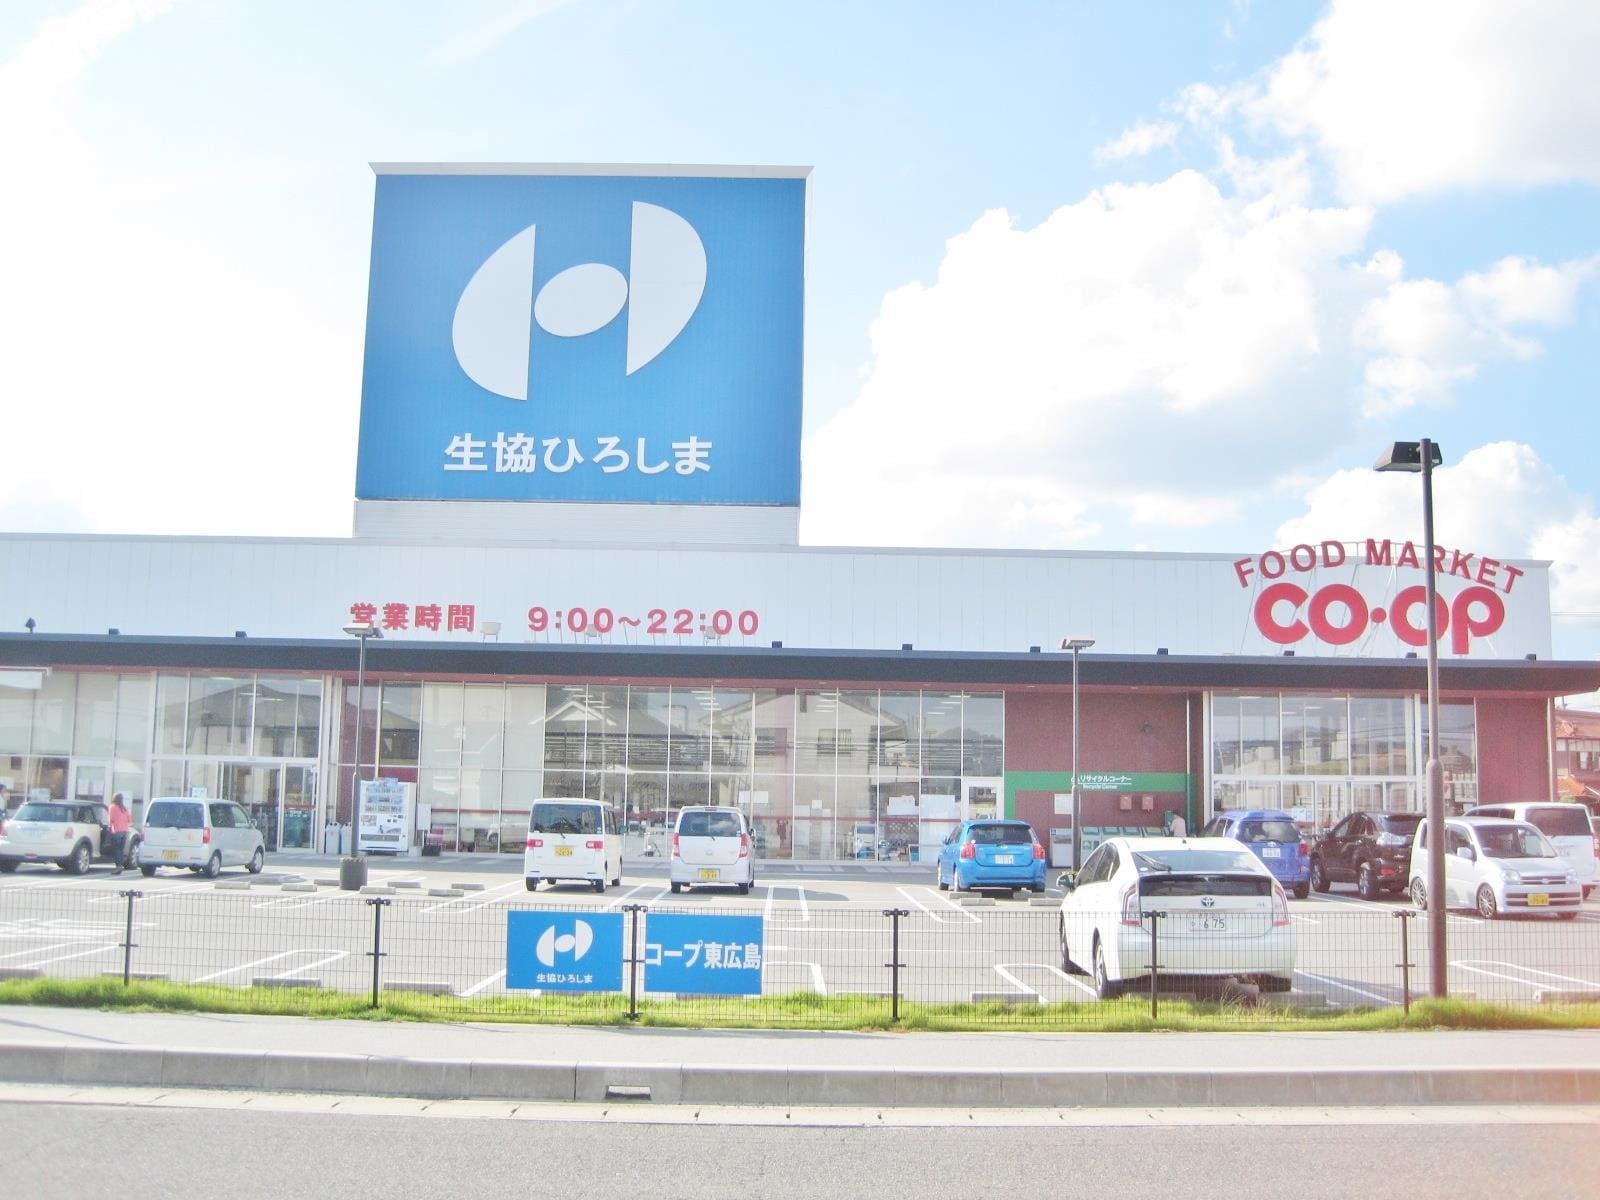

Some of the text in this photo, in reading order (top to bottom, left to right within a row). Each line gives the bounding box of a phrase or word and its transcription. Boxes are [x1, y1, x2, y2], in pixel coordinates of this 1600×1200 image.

[444, 432, 712, 475] 生協ひろしま
[1233, 538, 1523, 593] FOOD MARKET
[350, 602, 475, 632] 営業時間
[1080, 775, 1132, 783] リサイクルコーナー
[645, 939, 761, 970] コープ東広島
[536, 973, 593, 984] 生協ひろしま
